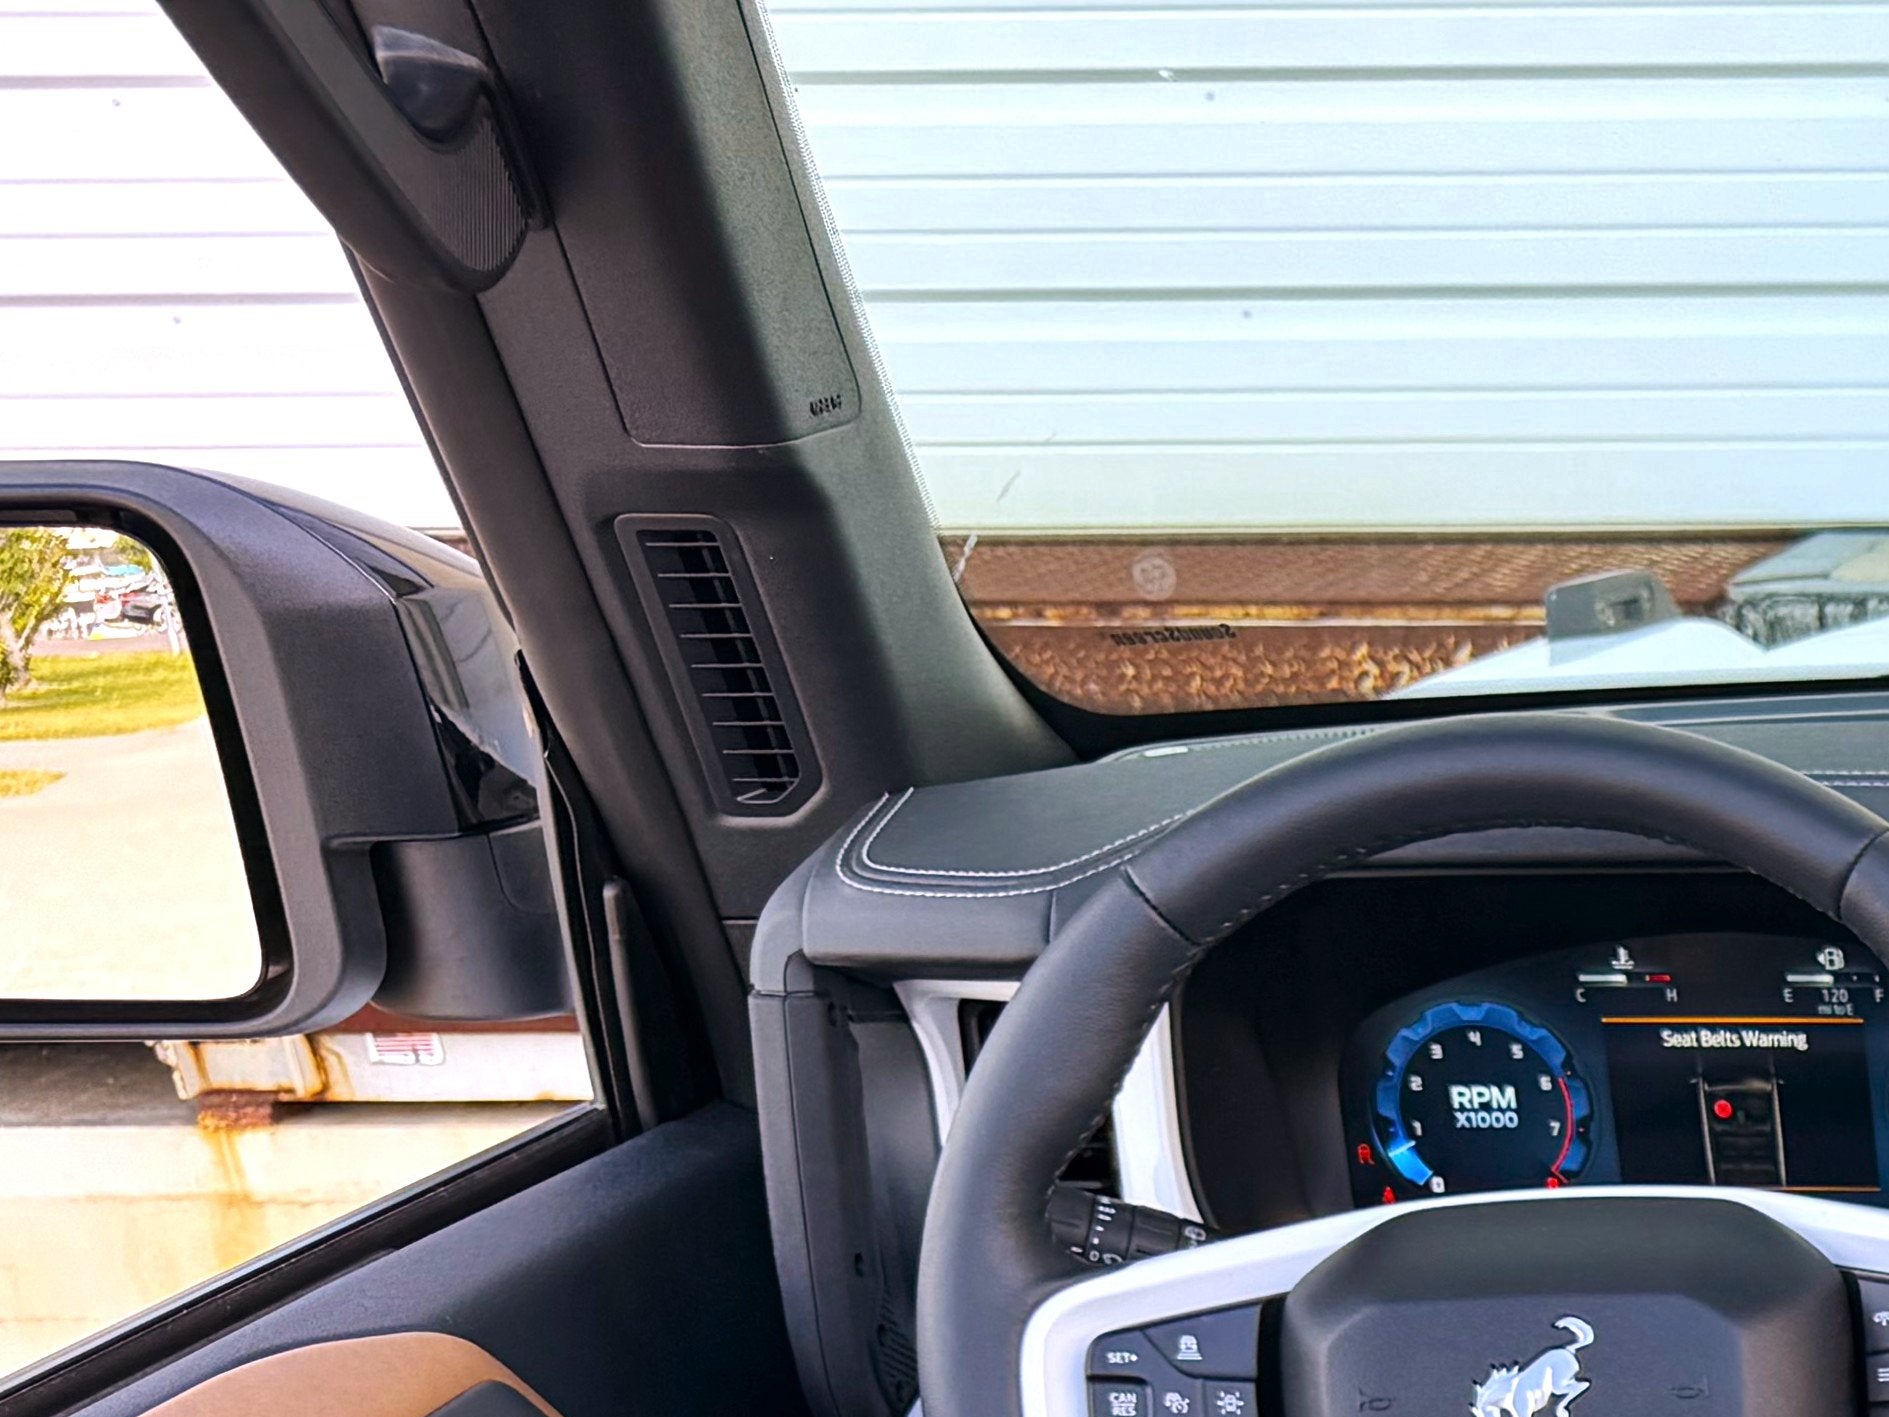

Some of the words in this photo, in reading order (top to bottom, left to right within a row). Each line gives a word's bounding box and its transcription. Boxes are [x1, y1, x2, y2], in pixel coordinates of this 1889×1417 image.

[1576, 988, 1586, 1002] C
[1666, 988, 1678, 1002] H
[1783, 988, 1794, 1003] E
[1821, 989, 1849, 1003] 120
[1874, 989, 1885, 1003] F
[1466, 1029, 1482, 1046] 4
[1661, 1029, 1699, 1048] Seat
[1700, 1030, 1741, 1048] Belts
[1742, 1031, 1809, 1051] Warning
[1428, 1042, 1443, 1060] 3
[1509, 1042, 1524, 1060] 5
[1409, 1074, 1423, 1091] 2
[1538, 1073, 1552, 1091] 6
[1448, 1085, 1518, 1109] RPM
[1411, 1119, 1422, 1137] 1
[1453, 1110, 1519, 1129] X1000
[1549, 1120, 1561, 1137] 7
[1429, 1174, 1445, 1193] 0
[1109, 1392, 1138, 1403] CAN
[1111, 1405, 1137, 1417] RES
